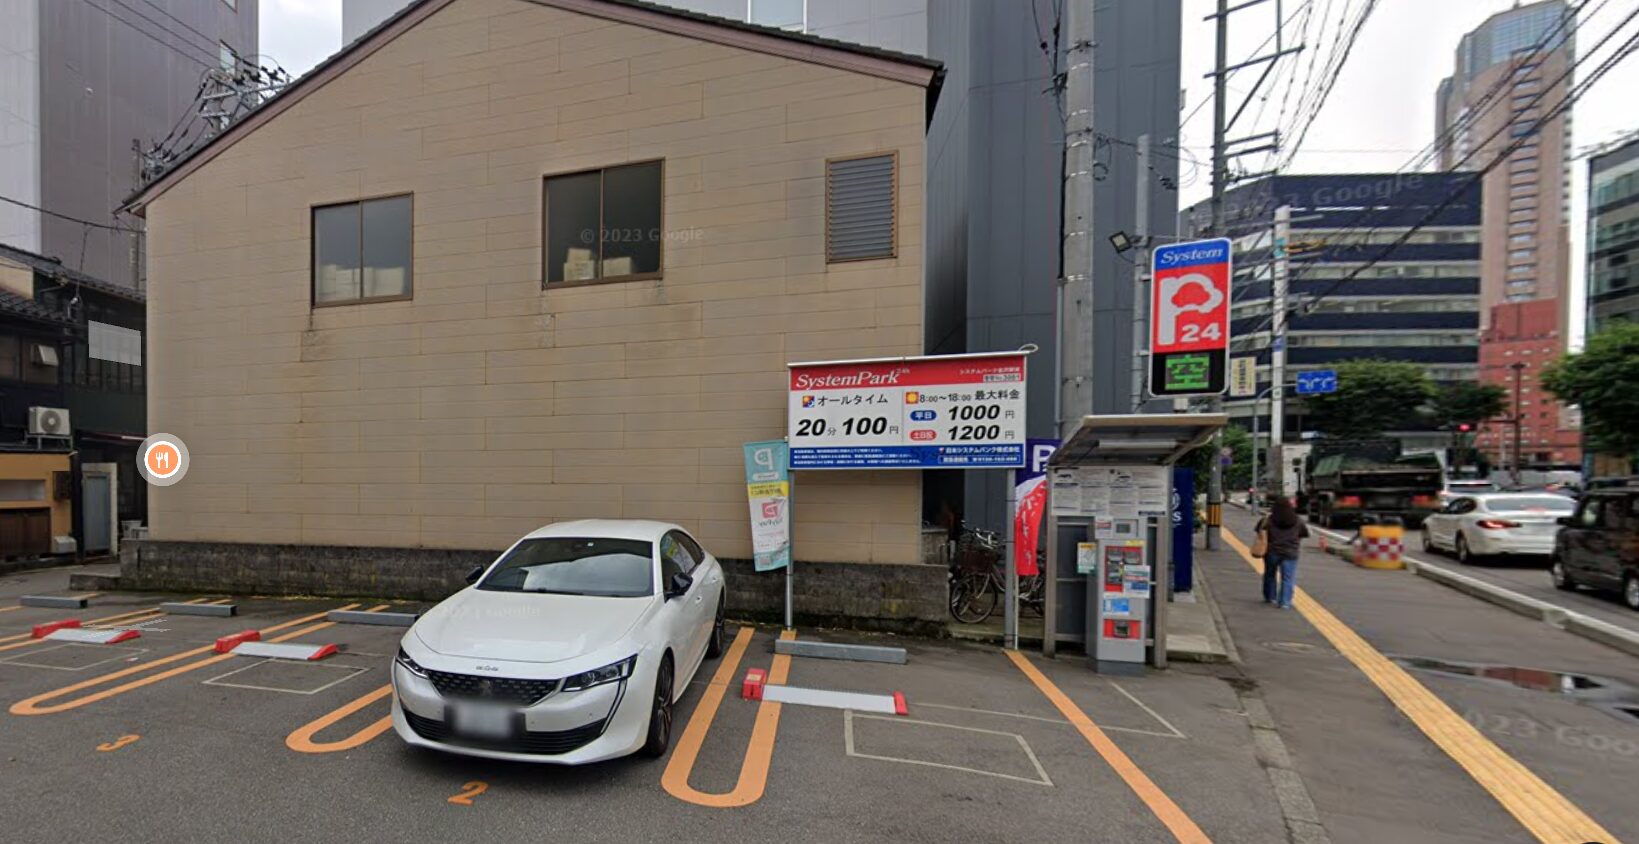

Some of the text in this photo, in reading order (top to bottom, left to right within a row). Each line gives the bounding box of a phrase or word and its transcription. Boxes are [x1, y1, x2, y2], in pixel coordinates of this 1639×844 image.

[1161, 248, 1223, 265] System
[1180, 322, 1222, 343] 24
[796, 370, 900, 390] SystemPark
[1165, 354, 1210, 390] 空
[817, 393, 888, 406] オールタイム
[975, 389, 1020, 400] 最大料金
[914, 411, 933, 420] 平日
[96, 734, 142, 752] 3
[448, 780, 490, 806] 2
